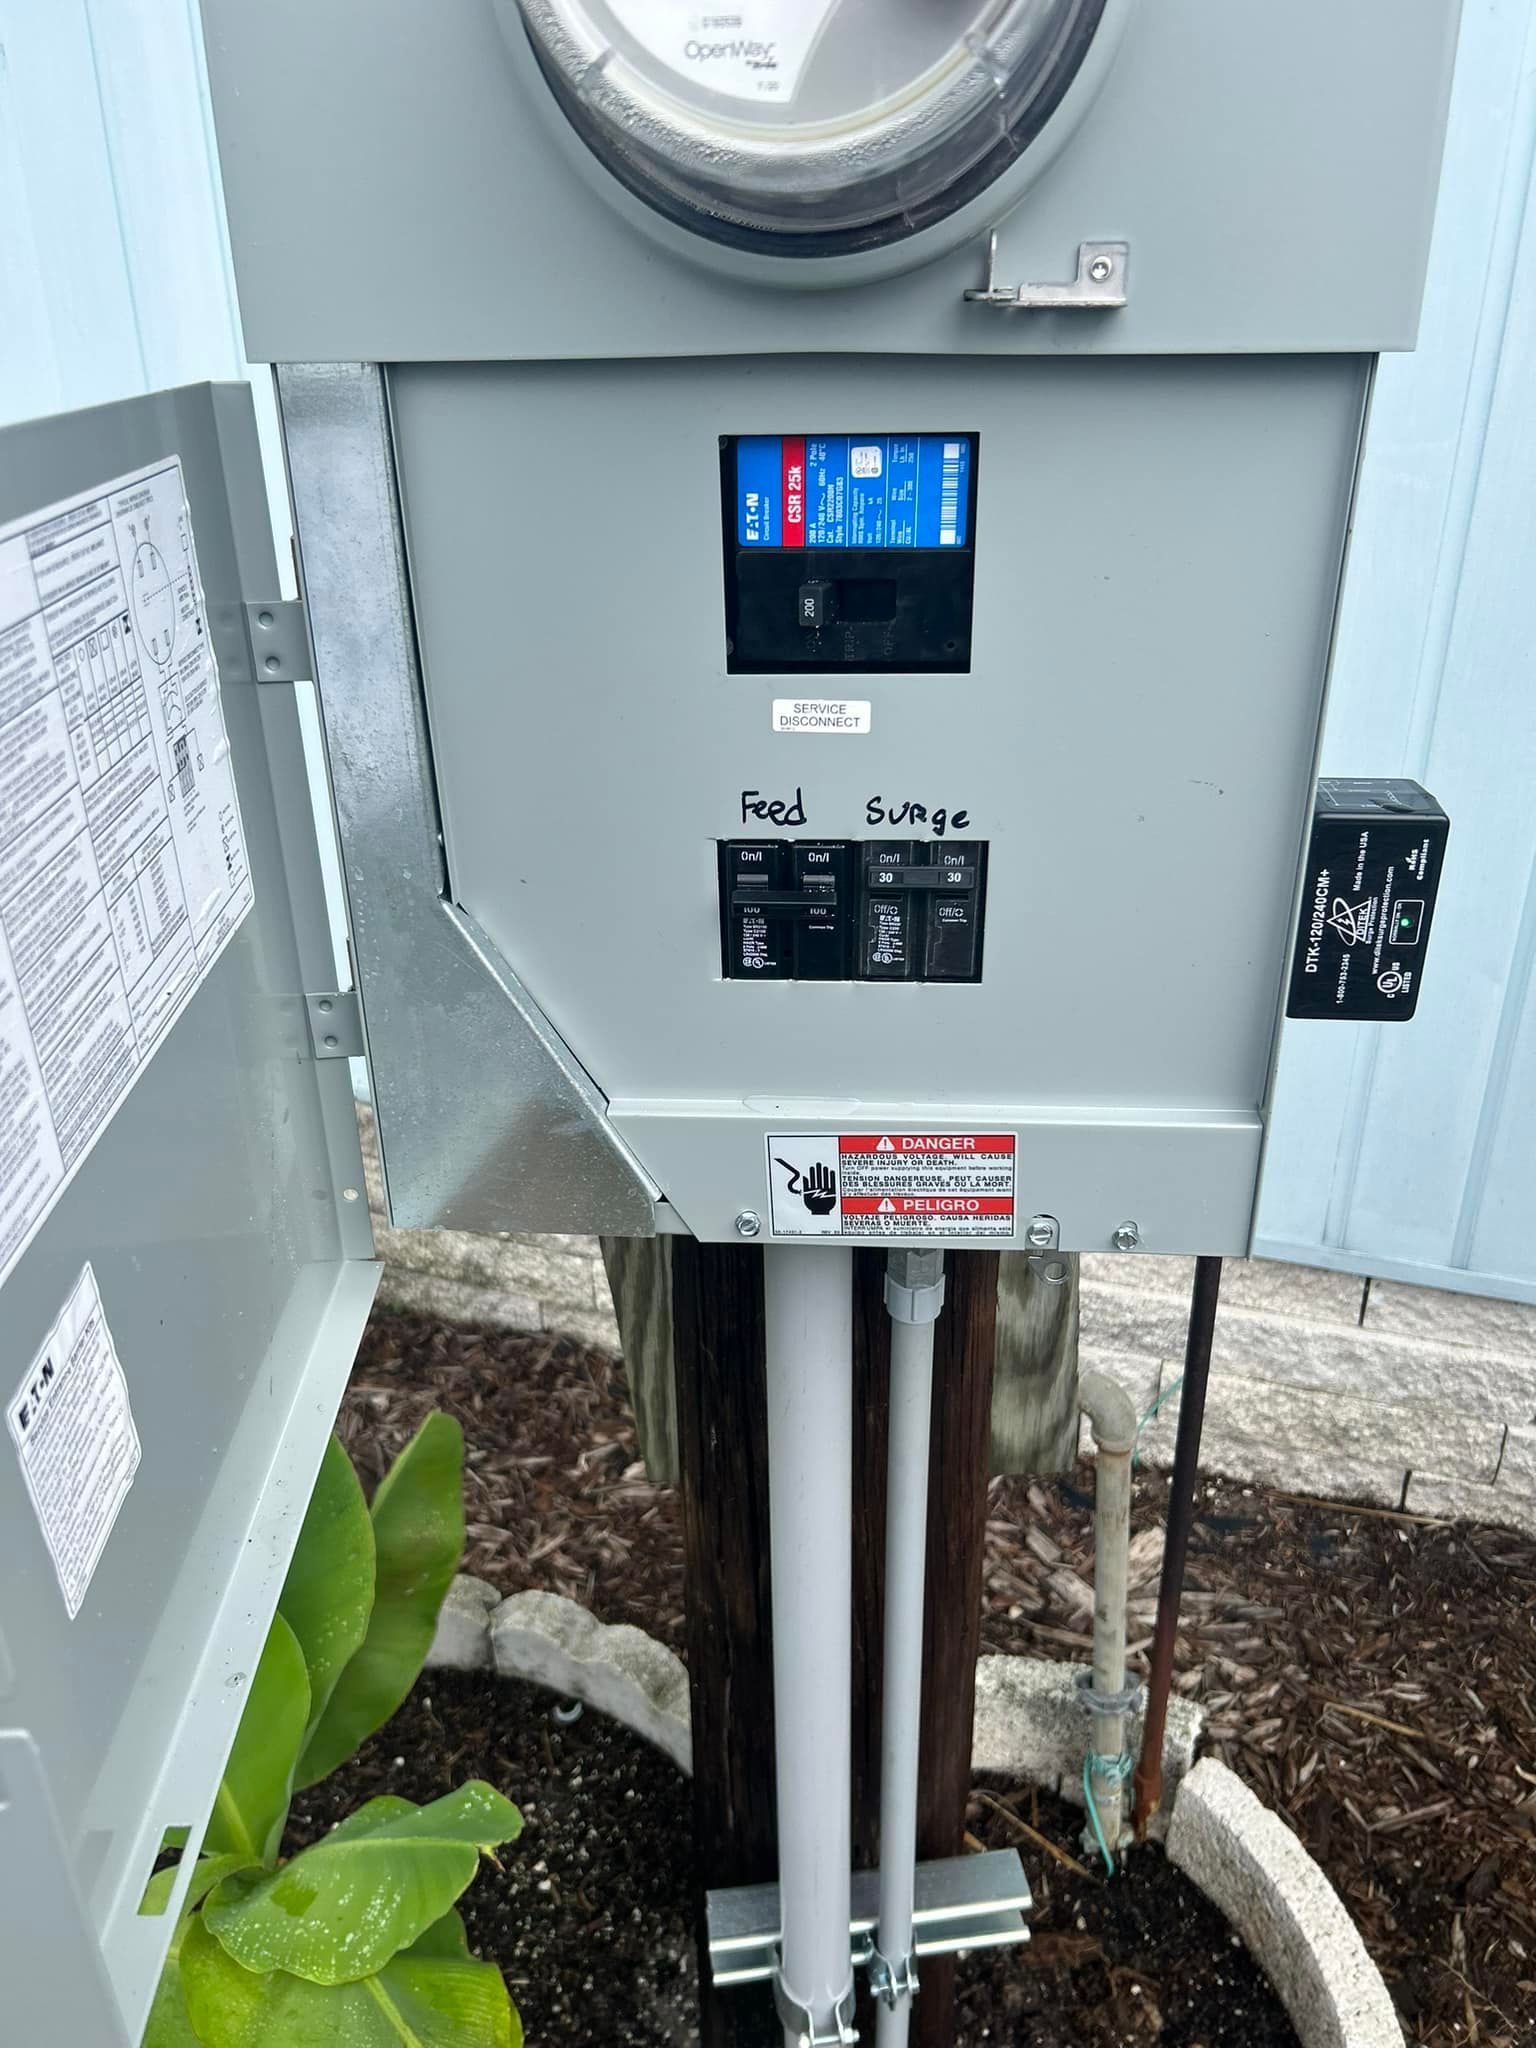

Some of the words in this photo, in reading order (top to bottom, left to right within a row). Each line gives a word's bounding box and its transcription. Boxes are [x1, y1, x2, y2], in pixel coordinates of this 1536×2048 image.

[684, 40, 776, 62] OpenWay
[788, 466, 802, 491] 25k
[788, 494, 802, 523] CSR
[836, 526, 844, 544] Style
[804, 598, 815, 618] 200
[794, 703, 847, 714] SERVICE
[780, 715, 860, 728] DISCONNECT
[741, 787, 808, 826] Feed
[1360, 831, 1369, 848] USA
[1358, 850, 1366, 862] the
[1416, 839, 1430, 880] Compliant
[879, 872, 893, 883] 30
[947, 872, 962, 883] 30
[1352, 873, 1362, 891] Made
[1367, 897, 1378, 926] Protection
[1372, 866, 1394, 974] www.diteksurgeprotection.com
[1305, 868, 1330, 974] DTK-120/240CM+
[1356, 908, 1368, 936] DITEK
[1366, 928, 1374, 944] Surge
[1382, 976, 1397, 989] UL
[1401, 972, 1412, 994] LISTED
[902, 1137, 976, 1150] DANGER
[903, 1200, 980, 1211] PELIGRO
